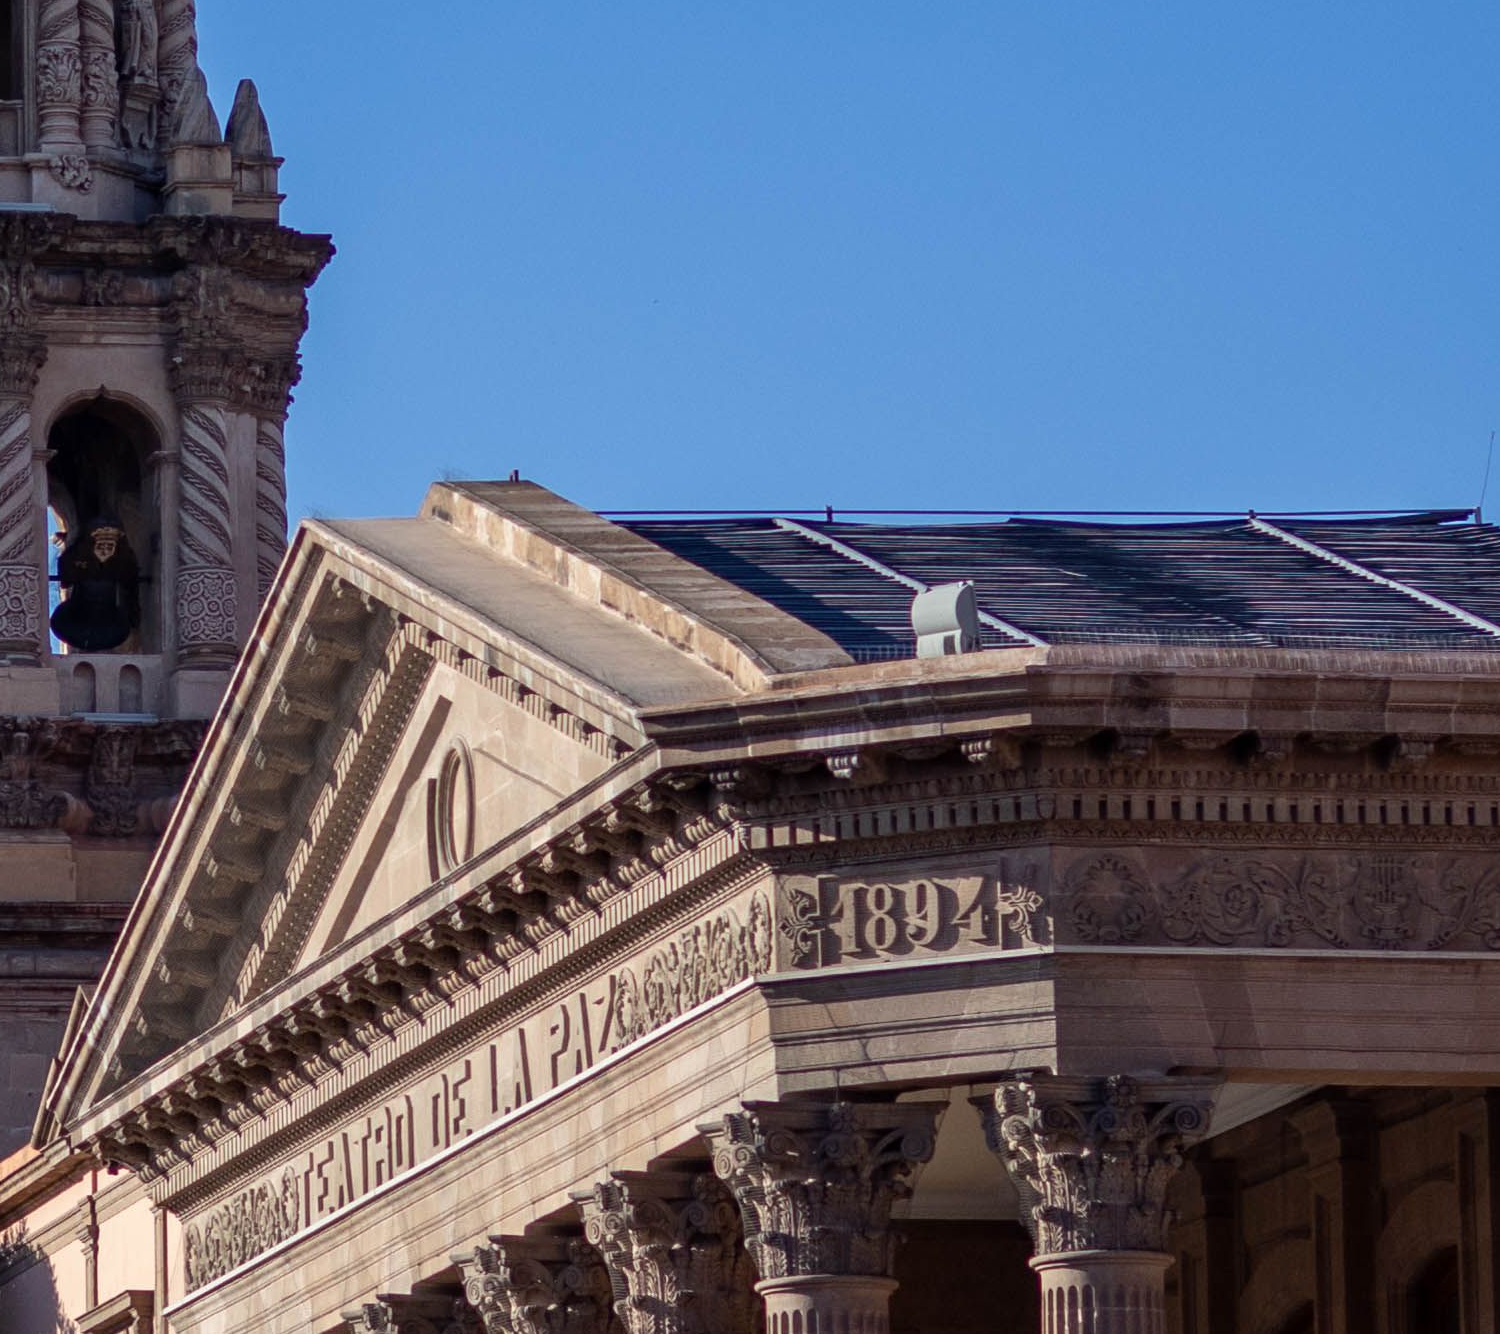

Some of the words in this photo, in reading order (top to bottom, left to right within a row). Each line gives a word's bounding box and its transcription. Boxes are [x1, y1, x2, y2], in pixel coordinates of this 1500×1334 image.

[829, 876, 989, 954] 1894
[297, 1095, 416, 1228] TEATRO
[424, 1058, 473, 1151] DE
[483, 1027, 534, 1117] LA
[547, 974, 618, 1091] PAZ
